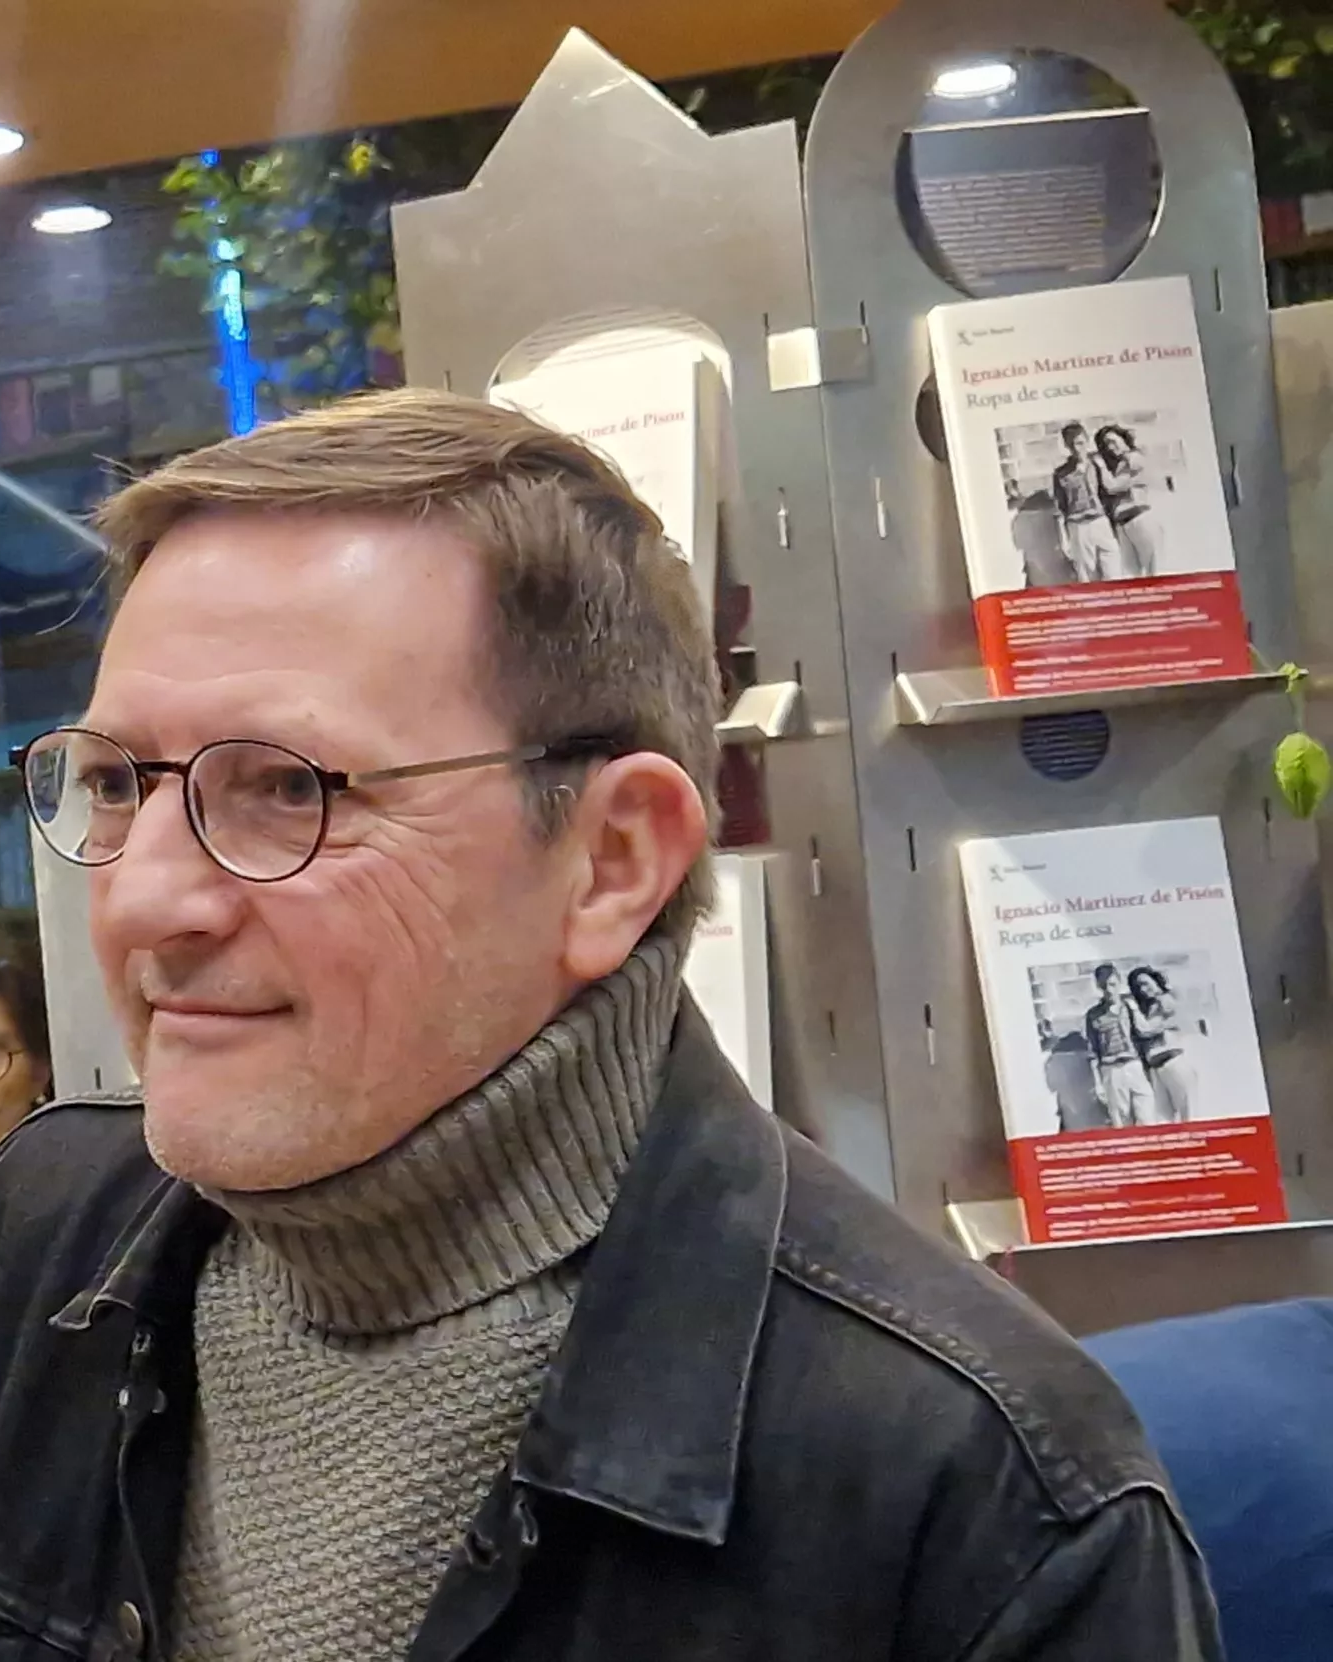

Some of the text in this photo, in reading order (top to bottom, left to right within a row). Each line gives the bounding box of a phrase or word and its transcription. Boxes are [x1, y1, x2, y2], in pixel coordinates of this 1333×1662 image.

[962, 365, 1029, 387] Ignacio
[1119, 348, 1140, 365] de
[966, 383, 1081, 410] Ropa de casa
[620, 413, 639, 433] de
[995, 904, 1061, 925] Ignacio
[1150, 888, 1172, 905] de
[998, 923, 1114, 949] Ropa de casa
